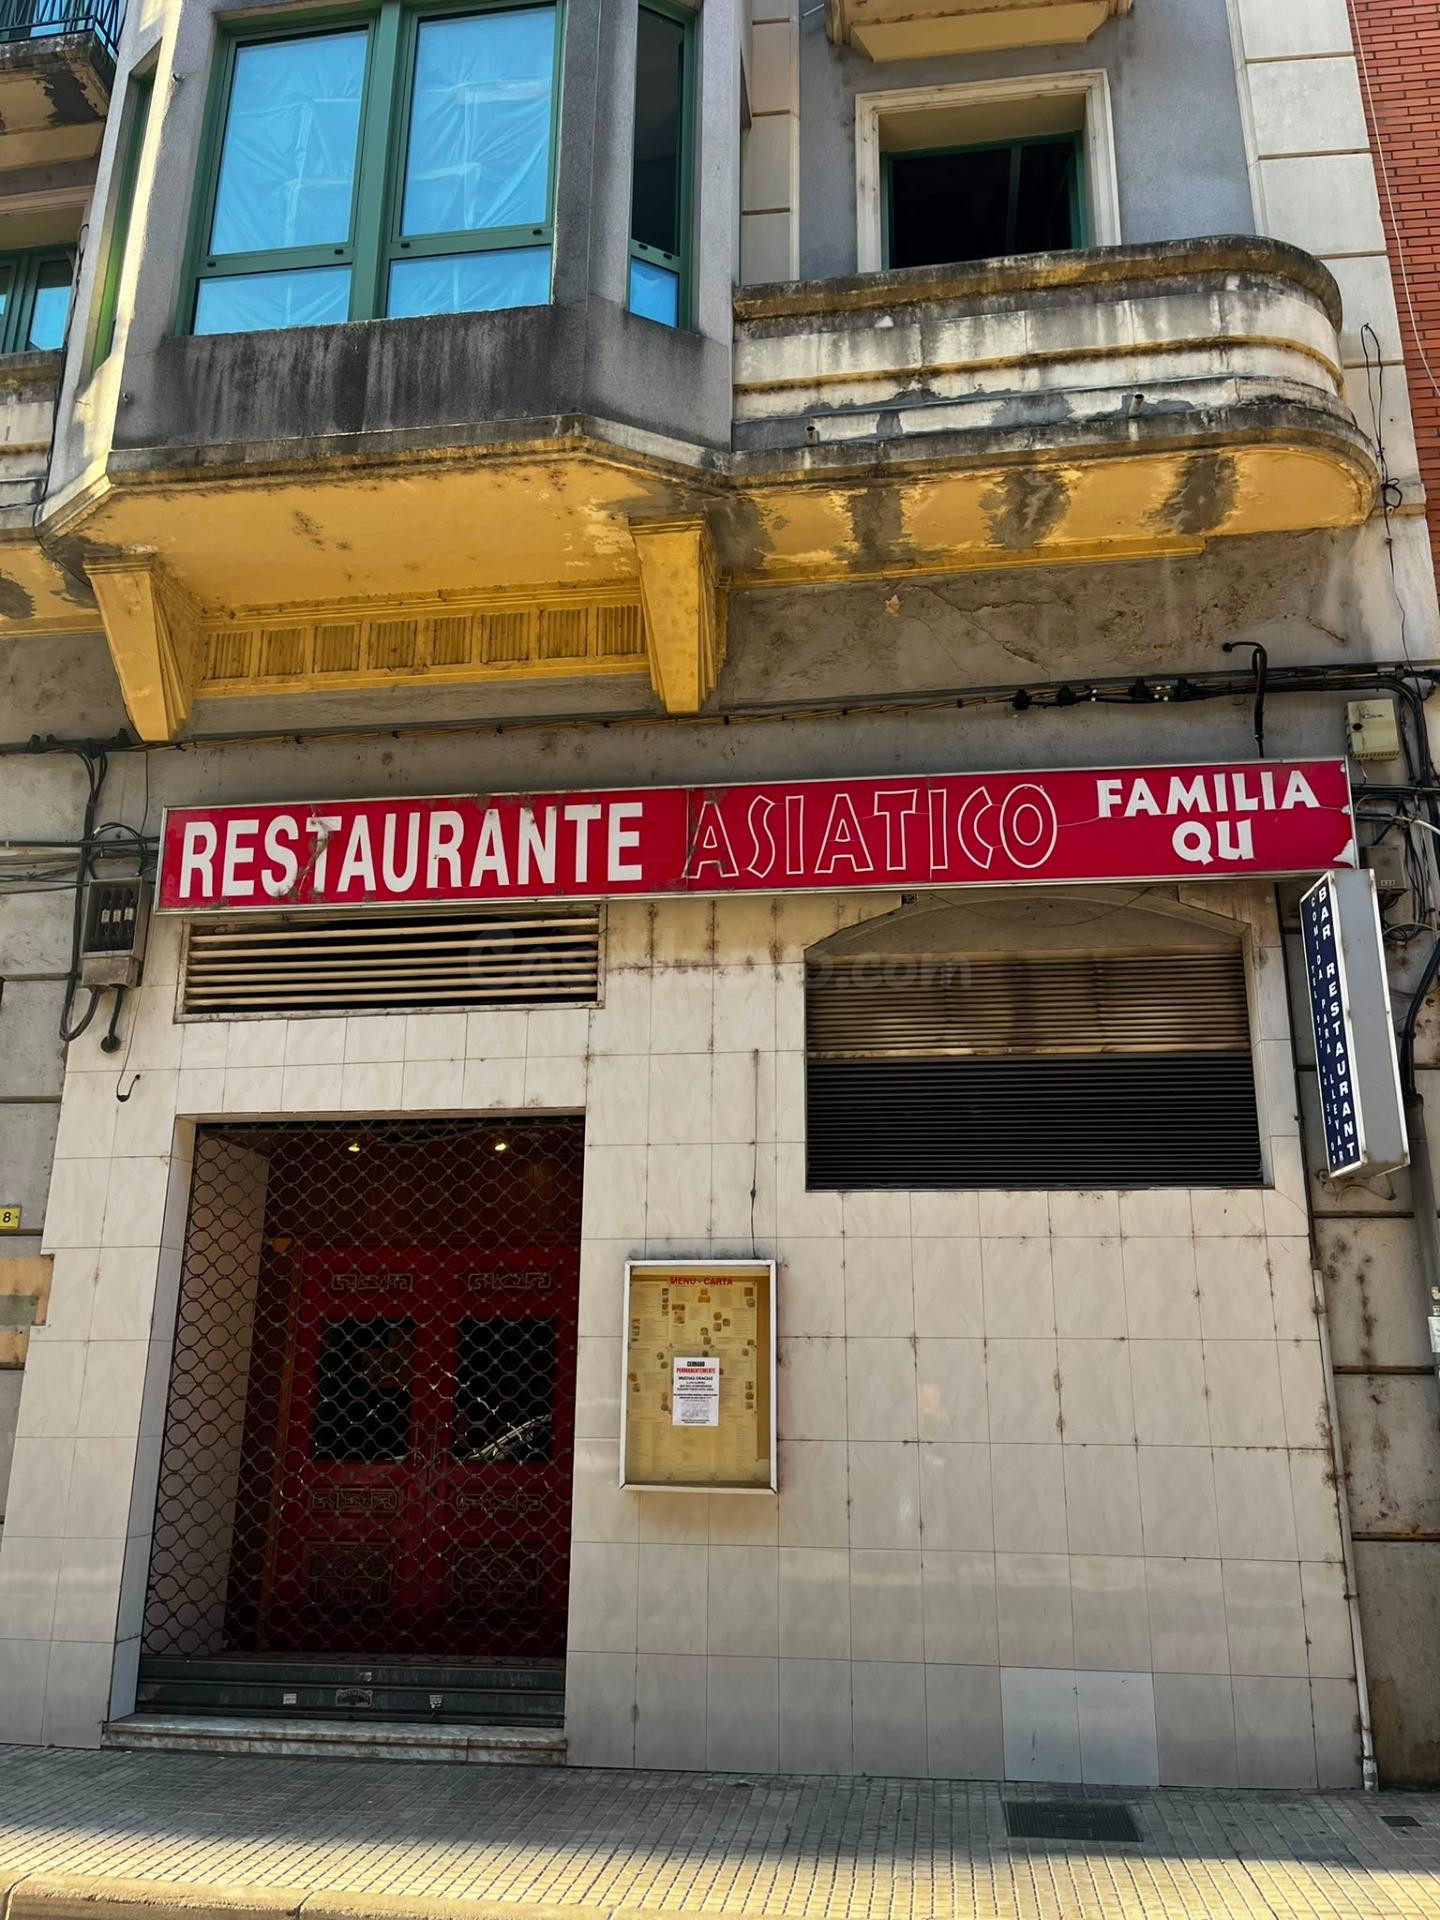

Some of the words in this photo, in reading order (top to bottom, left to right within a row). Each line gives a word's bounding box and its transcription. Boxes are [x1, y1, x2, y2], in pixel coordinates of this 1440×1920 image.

[1097, 771, 1319, 818] FAMILIA
[179, 802, 642, 898] RESTAURANTE
[681, 783, 1057, 878] ASIATICO
[1172, 818, 1254, 865] QU
[1311, 896, 1323, 980] COMIDA
[1321, 998, 1331, 1055] PARA
[1329, 1073, 1344, 1162] LLEVAR
[1318, 886, 1331, 941] BAR
[1326, 961, 1355, 1157] RESTAURANT
[2, 1211, 12, 1223] 8
[703, 1276, 734, 1286] CARTA
